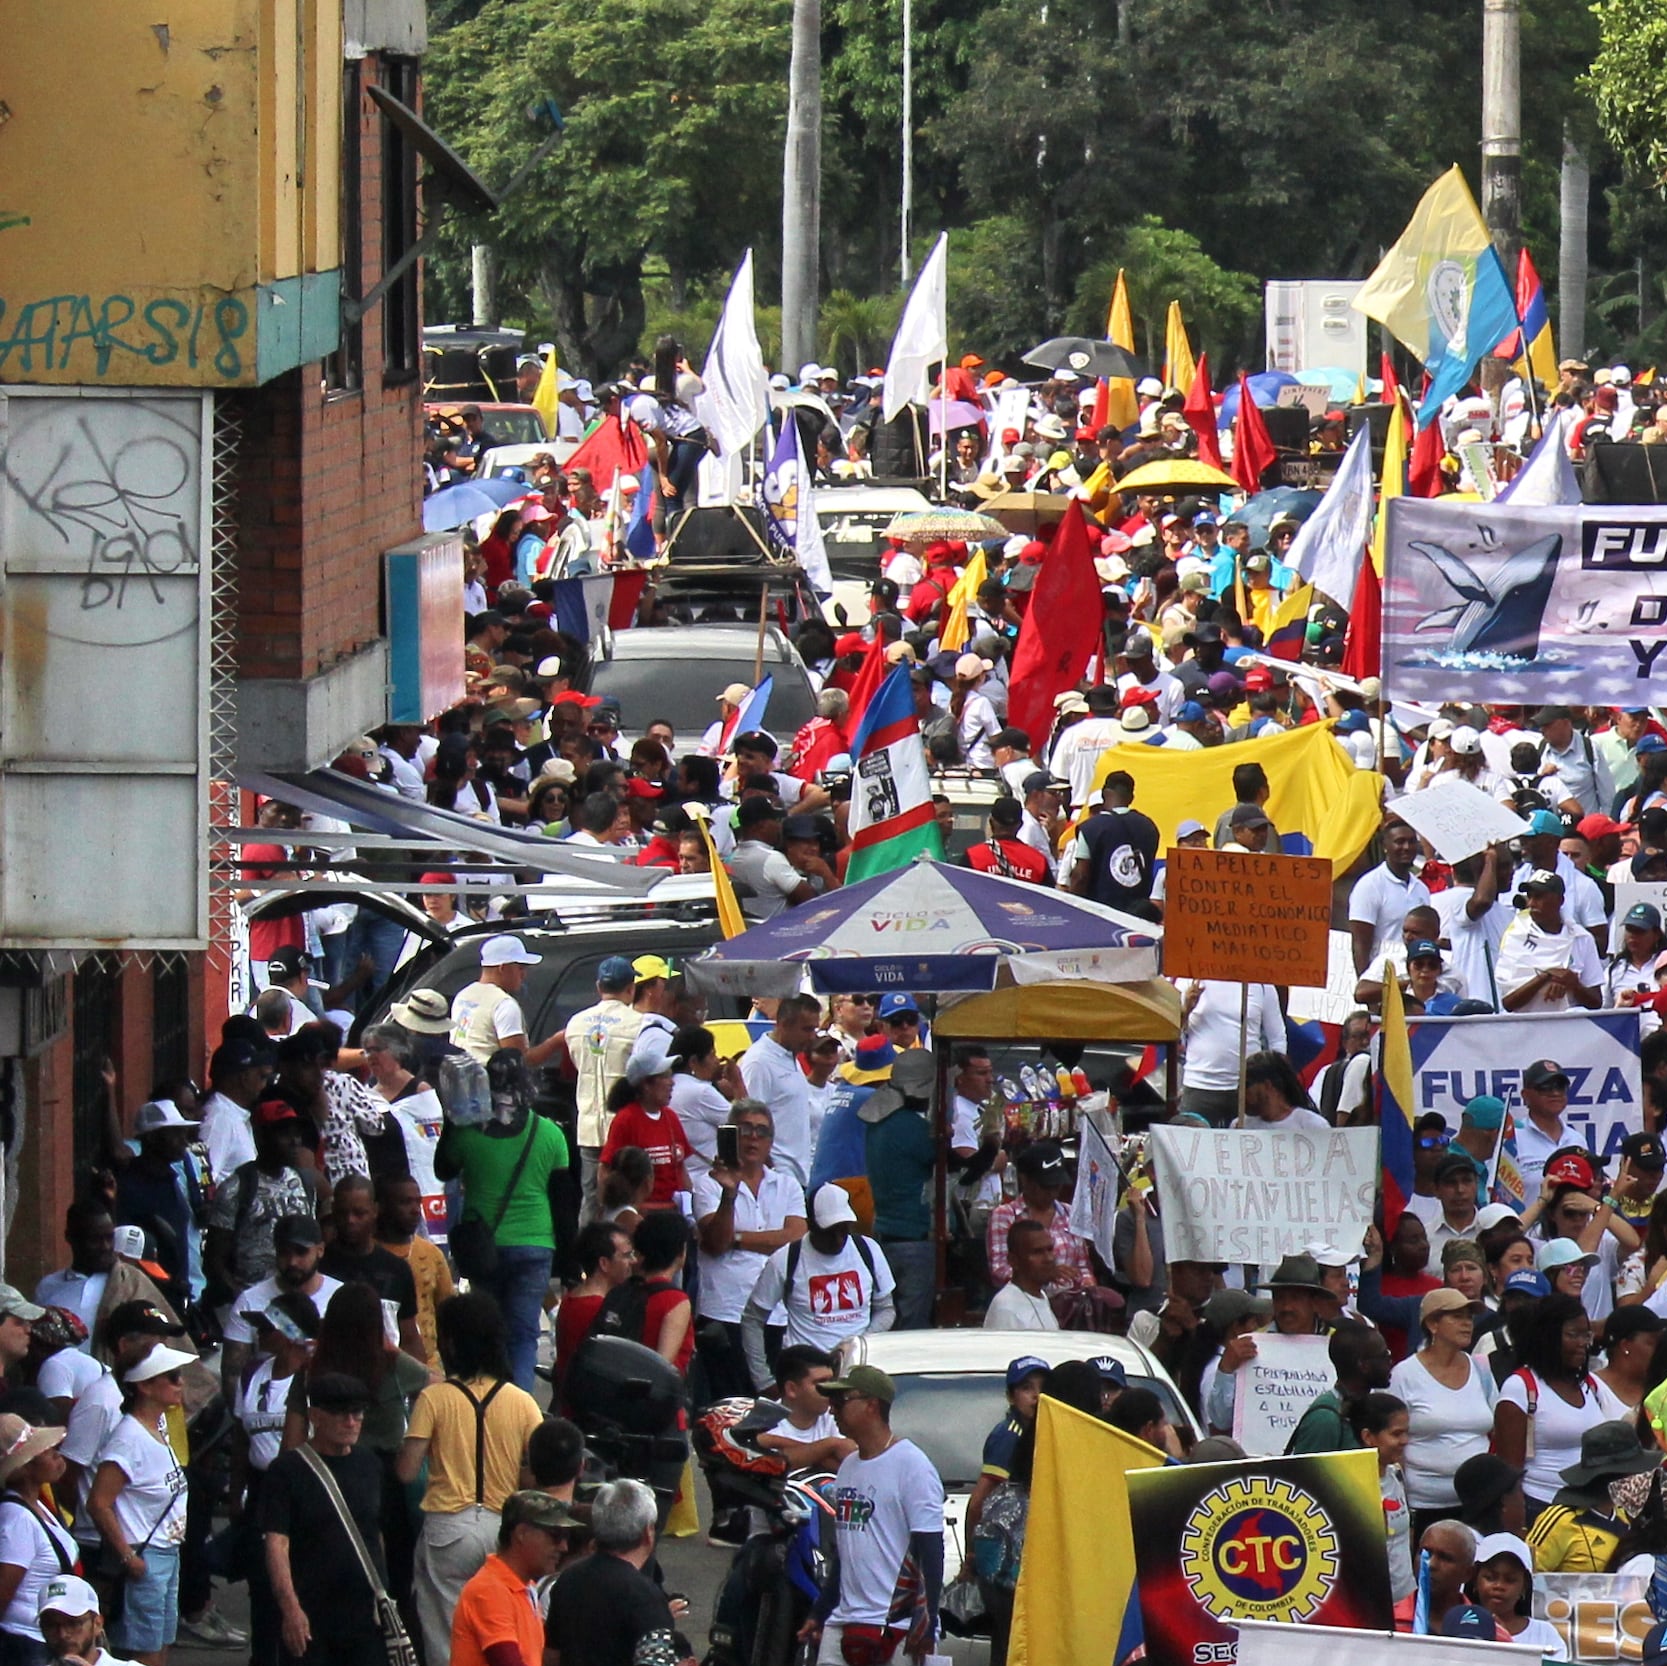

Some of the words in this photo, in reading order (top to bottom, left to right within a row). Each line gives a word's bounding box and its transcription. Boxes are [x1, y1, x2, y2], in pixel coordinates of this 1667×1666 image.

[1631, 640, 1667, 679] Y
[1177, 855, 1203, 871] LA
[1216, 856, 1280, 877] PELEA
[1293, 862, 1321, 879] ES
[1179, 876, 1256, 896] CONTRA
[1269, 885, 1292, 900] EL
[1178, 895, 1237, 916] PODER
[871, 919, 950, 932] VIDA
[1186, 938, 1194, 954] Y
[1167, 1130, 1356, 1178] VEREDA
[1217, 1534, 1302, 1575] CTC
